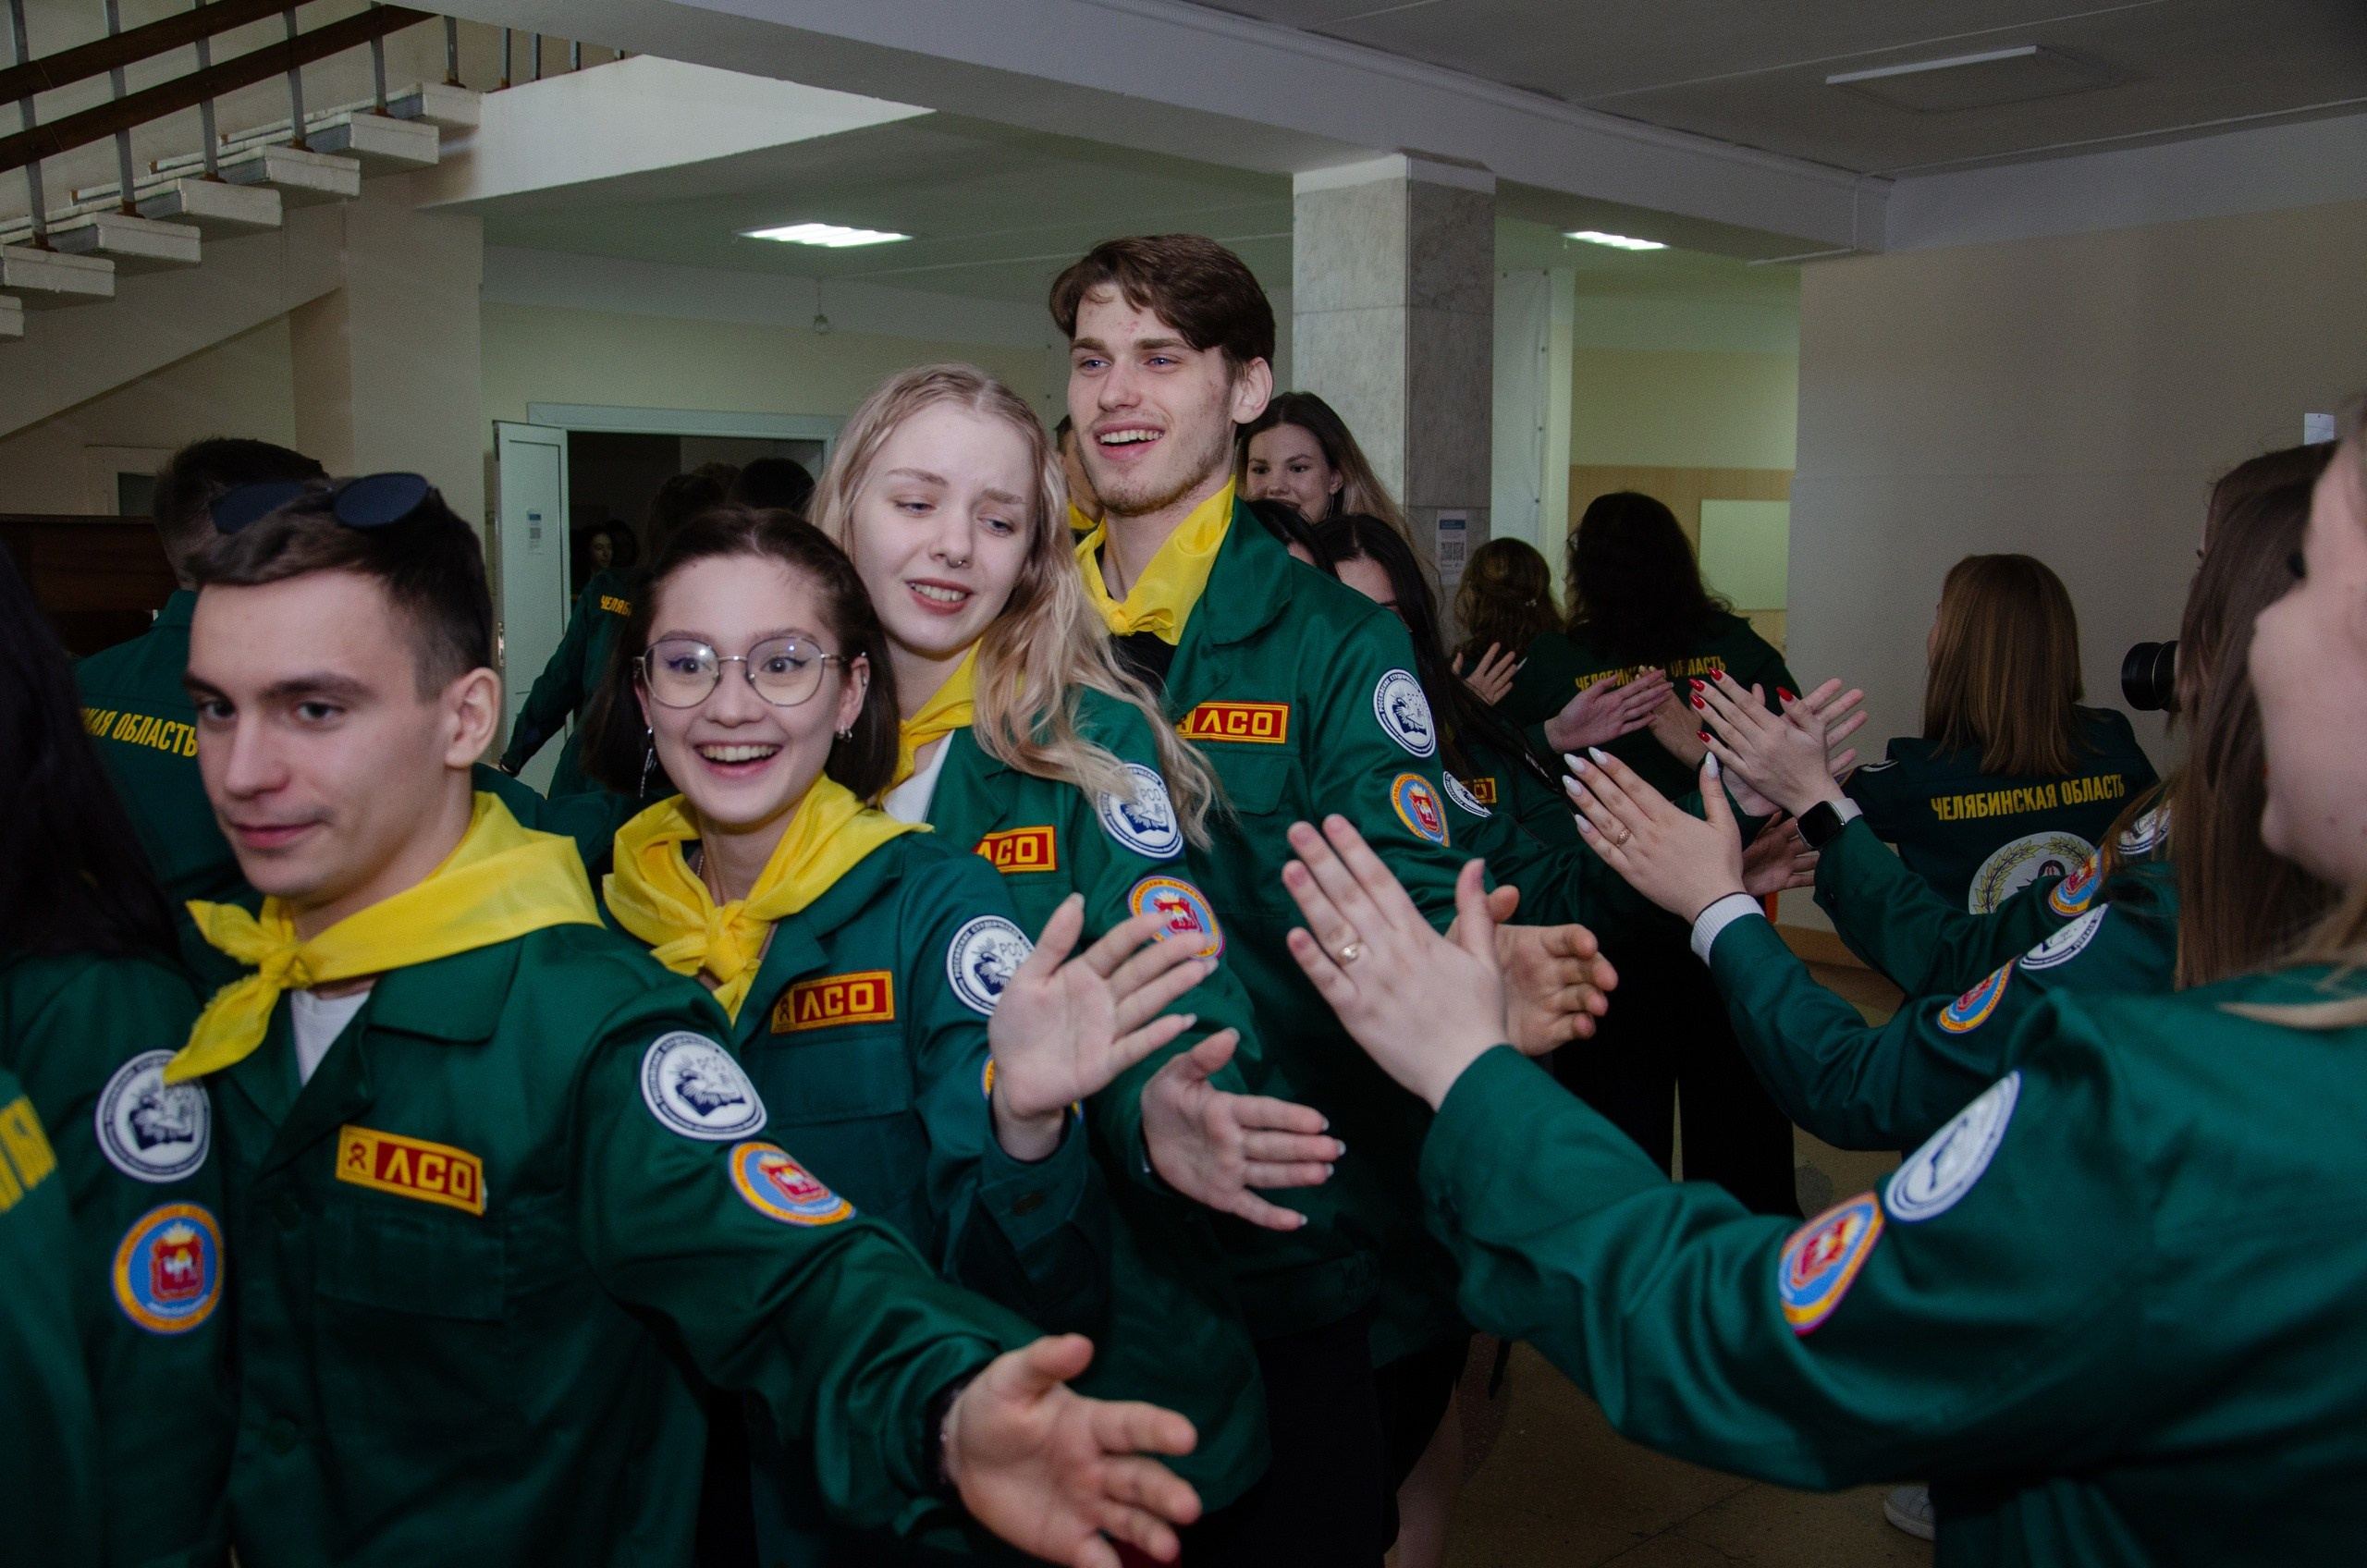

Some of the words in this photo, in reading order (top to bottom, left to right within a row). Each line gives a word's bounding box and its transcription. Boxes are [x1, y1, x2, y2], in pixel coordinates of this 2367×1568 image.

[112, 712, 198, 757] ОБЛАСТЬ
[1931, 784, 2057, 821] ЧЕЛЯБИНСКАЯ
[2061, 774, 2125, 805] ОБЛАСТЬ
